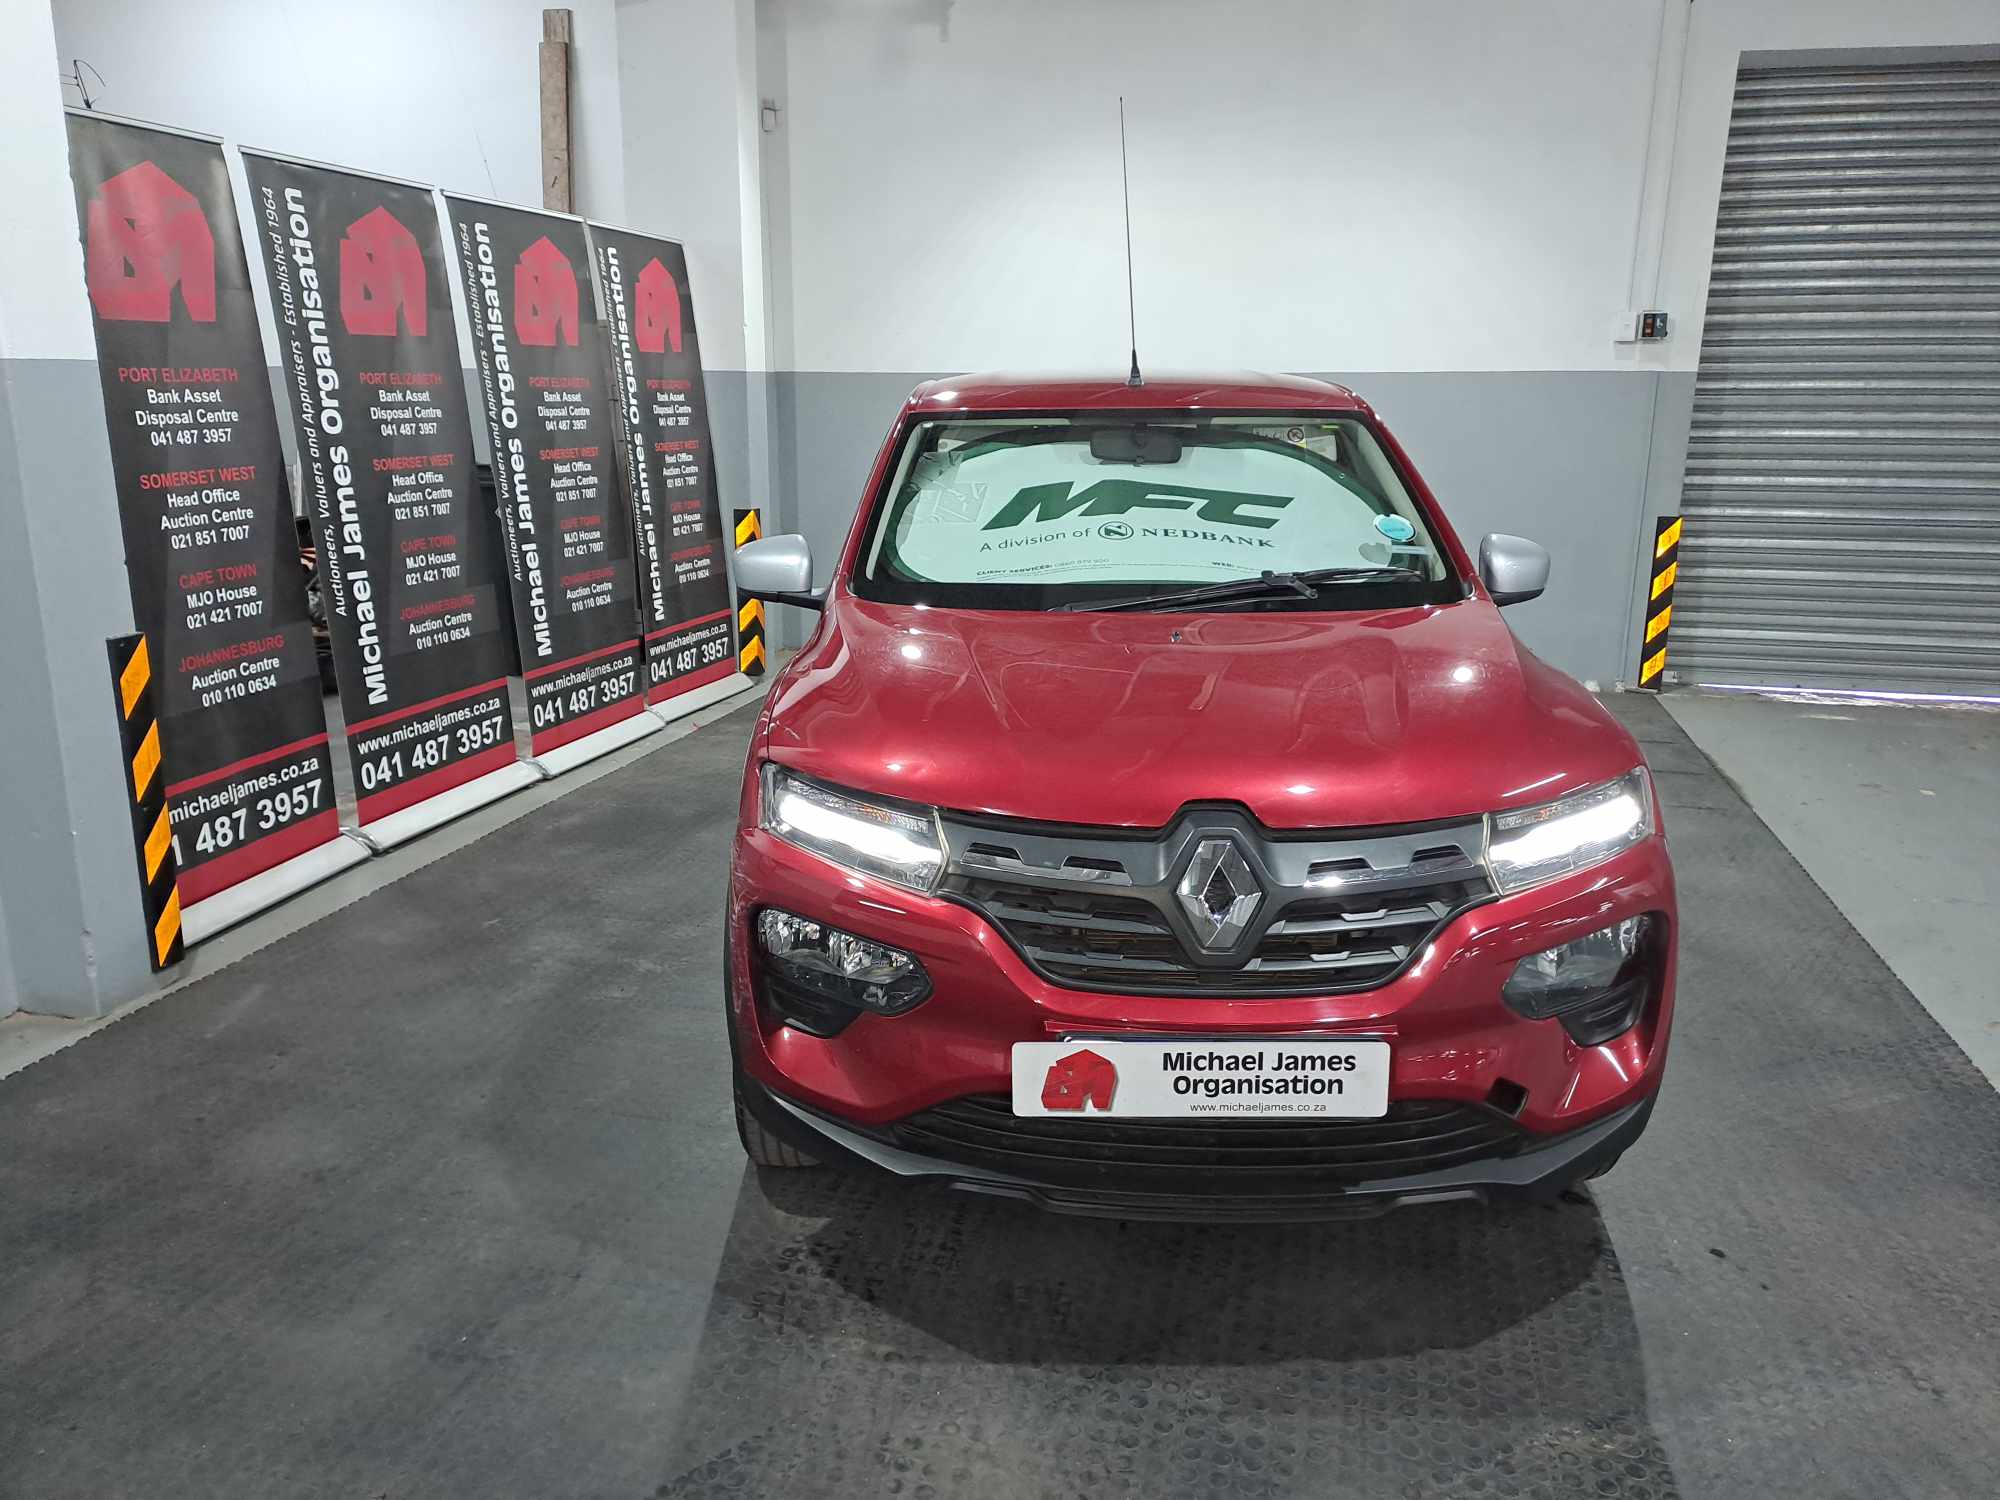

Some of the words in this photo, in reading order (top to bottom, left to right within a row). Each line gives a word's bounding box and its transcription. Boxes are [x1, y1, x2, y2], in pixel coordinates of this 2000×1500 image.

[261, 186, 280, 228] 1964
[459, 222, 472, 257] 1964
[273, 232, 297, 326] Established
[285, 187, 343, 435] Organisation
[464, 260, 485, 338] Established
[475, 222, 518, 429] Organisation
[607, 247, 640, 424] Organisation
[118, 368, 158, 383] PORT
[161, 368, 238, 383] ELIZABETH
[291, 340, 316, 424] Appraisers
[480, 350, 497, 419] Appraisers
[146, 388, 181, 404] Bank
[184, 388, 222, 403] Asset
[379, 390, 404, 402] Bank
[405, 390, 431, 402] Asset
[135, 410, 193, 427] Disposal
[196, 409, 239, 423] Centre
[370, 407, 412, 421] Disposal
[414, 406, 442, 418] Centre
[381, 424, 397, 436] 041
[400, 423, 416, 435] 487
[419, 422, 437, 435] 3957
[150, 431, 173, 446] 041
[176, 430, 198, 445] 487
[203, 428, 232, 443] 3957
[304, 427, 319, 458] and
[490, 422, 501, 448] and
[139, 469, 215, 489] SOMERSET
[218, 465, 256, 482] WEST
[392, 473, 416, 486] Head
[418, 472, 444, 484] Office
[496, 452, 509, 500] Valuers
[551, 477, 575, 488] Auction
[554, 463, 570, 473] Head
[634, 433, 652, 516] James
[166, 491, 199, 508] Head
[201, 488, 240, 504] Office
[313, 461, 329, 519] Valuers
[387, 490, 423, 504] Auction
[425, 488, 453, 500] Centre
[508, 437, 535, 534] James
[161, 512, 209, 530] Auction
[211, 507, 254, 522] Centre
[329, 445, 365, 561] James
[395, 507, 411, 520] 021
[413, 505, 429, 518] 851
[431, 502, 450, 516] 7007
[980, 479, 1295, 532] MFC
[171, 533, 192, 549] 021
[195, 529, 217, 545] 851
[220, 525, 249, 541] 7007
[504, 504, 522, 582] Auctioneers,
[579, 531, 600, 540] House
[979, 542, 992, 552] A
[998, 531, 1066, 550] division
[1072, 528, 1091, 538] of
[1141, 527, 1277, 548] NEDBANK
[179, 570, 214, 589] CAPE
[216, 563, 257, 581] TOWN
[320, 525, 347, 617] Auctioneers,
[406, 555, 426, 569] MJO
[428, 553, 456, 565] House
[406, 572, 421, 585] 021
[423, 569, 439, 582] 421
[441, 565, 460, 579] 7007
[644, 523, 665, 621] Michael
[186, 590, 213, 609] MJO
[216, 585, 257, 602] House
[522, 541, 552, 657] Michael
[566, 586, 591, 599] Auction
[186, 613, 207, 629] 021
[210, 607, 231, 623] 421
[234, 600, 262, 618] 7007
[409, 619, 443, 635] Auction
[444, 612, 472, 626] Centre
[179, 634, 285, 672] JOHANNESBURG
[347, 570, 388, 706] Michael
[417, 636, 432, 649] 010
[433, 631, 448, 645] 110
[450, 627, 470, 641] 0634
[650, 624, 727, 656] www.michaeljames.co.za
[192, 668, 237, 690] Auction
[240, 657, 279, 676] Centre
[651, 656, 672, 682] 041
[677, 648, 696, 671] 487
[701, 637, 728, 662] 3957
[202, 690, 222, 707] 010
[224, 683, 245, 699] 110
[248, 674, 276, 693] 0634
[531, 656, 632, 697] www.michaeljames.co.za
[534, 697, 564, 727] 041
[569, 685, 596, 713] 487
[600, 671, 635, 702] 3957
[358, 698, 500, 755] www.michaeljames.co.za
[361, 752, 403, 789] 041
[412, 734, 449, 769] 487
[456, 716, 502, 754] 3957
[195, 808, 247, 854] 487
[256, 778, 322, 830] 3957
[1162, 1052, 1264, 1072] Michael
[1271, 1052, 1357, 1073] James
[1173, 1075, 1344, 1098] Organisation
[1190, 1102, 1328, 1114] www.michaeljames.co.za
